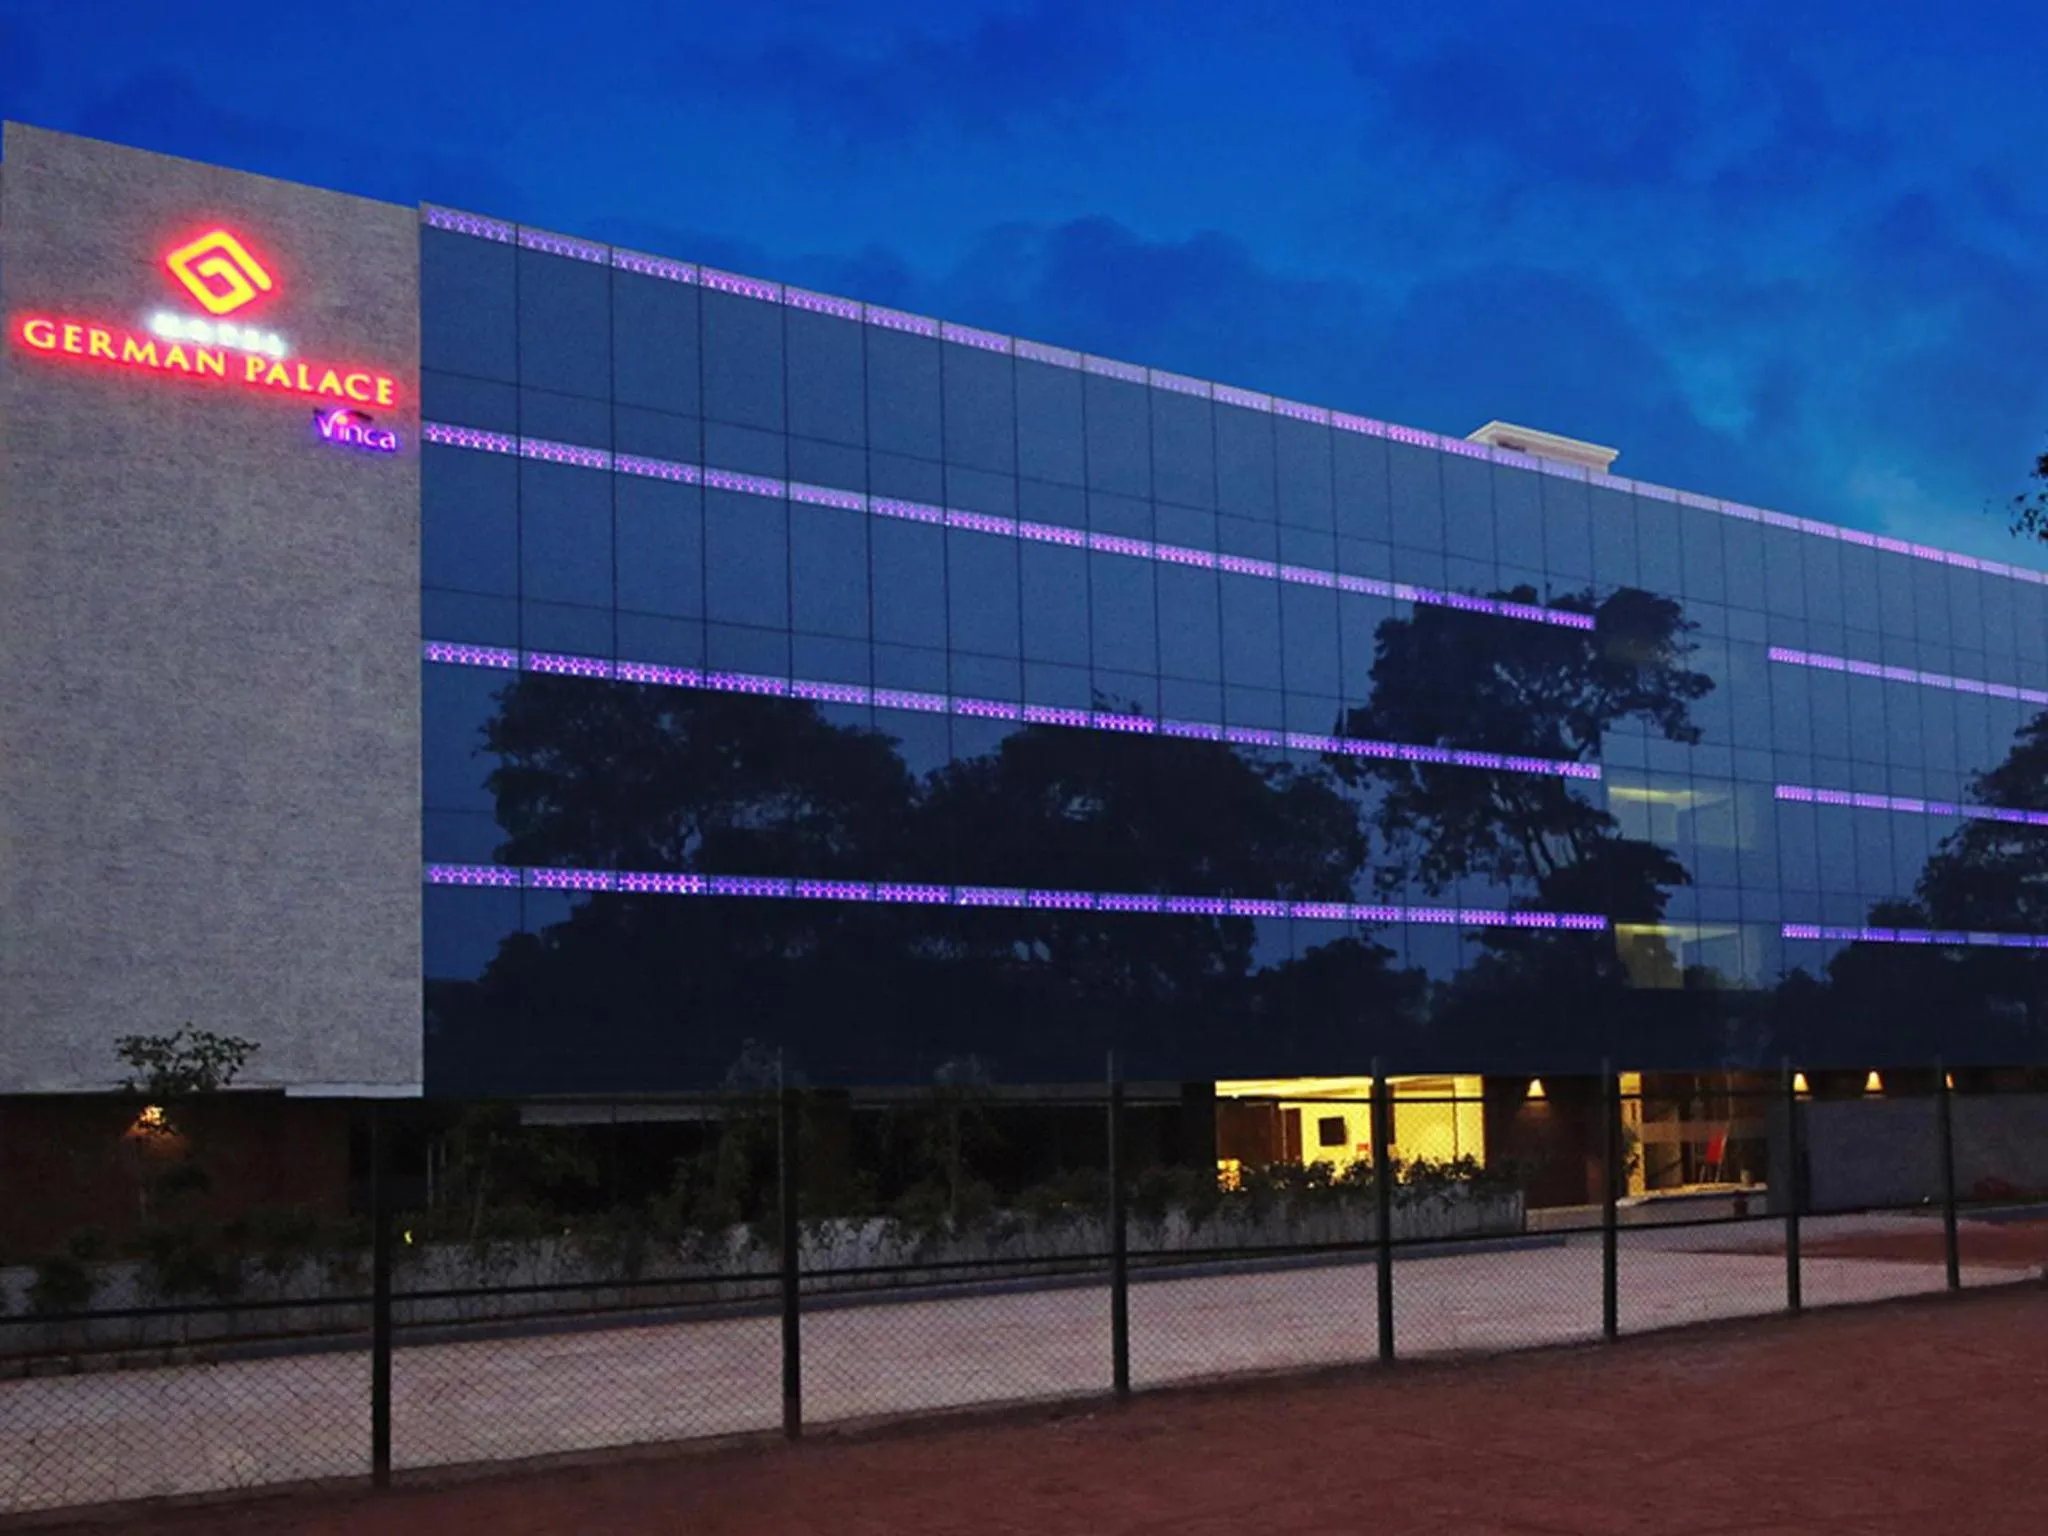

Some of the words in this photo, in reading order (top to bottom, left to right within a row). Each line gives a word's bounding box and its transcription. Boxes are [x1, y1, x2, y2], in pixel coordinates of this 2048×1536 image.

[23, 318, 225, 376] GERMAN
[244, 355, 394, 405] PALACE
[315, 408, 396, 450] Vinca
